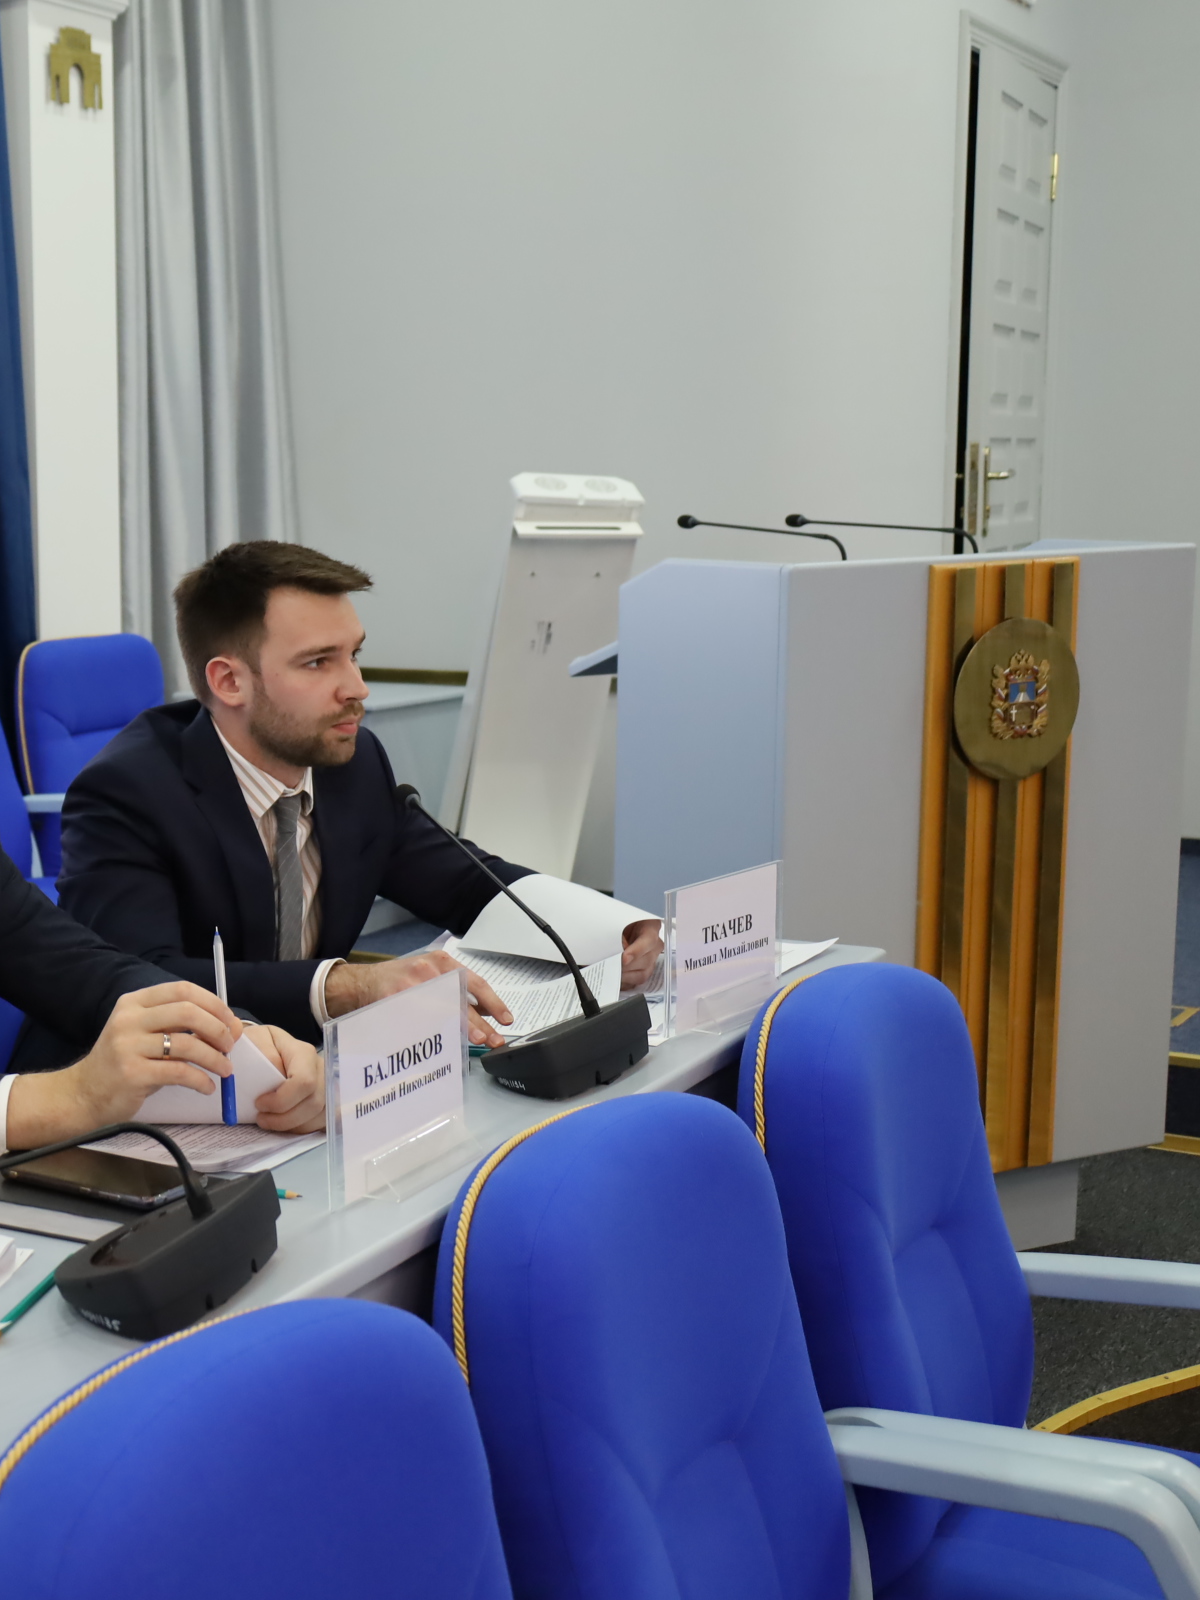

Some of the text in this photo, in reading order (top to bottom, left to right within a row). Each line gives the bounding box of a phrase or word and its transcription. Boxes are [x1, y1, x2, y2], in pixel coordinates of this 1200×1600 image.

[702, 913, 753, 944] ТКАЧЕВ
[684, 936, 769, 972] Михаил Михайлович
[363, 1033, 443, 1089] БАЛЮКОВ
[355, 1063, 452, 1119] Николай Николаевич
